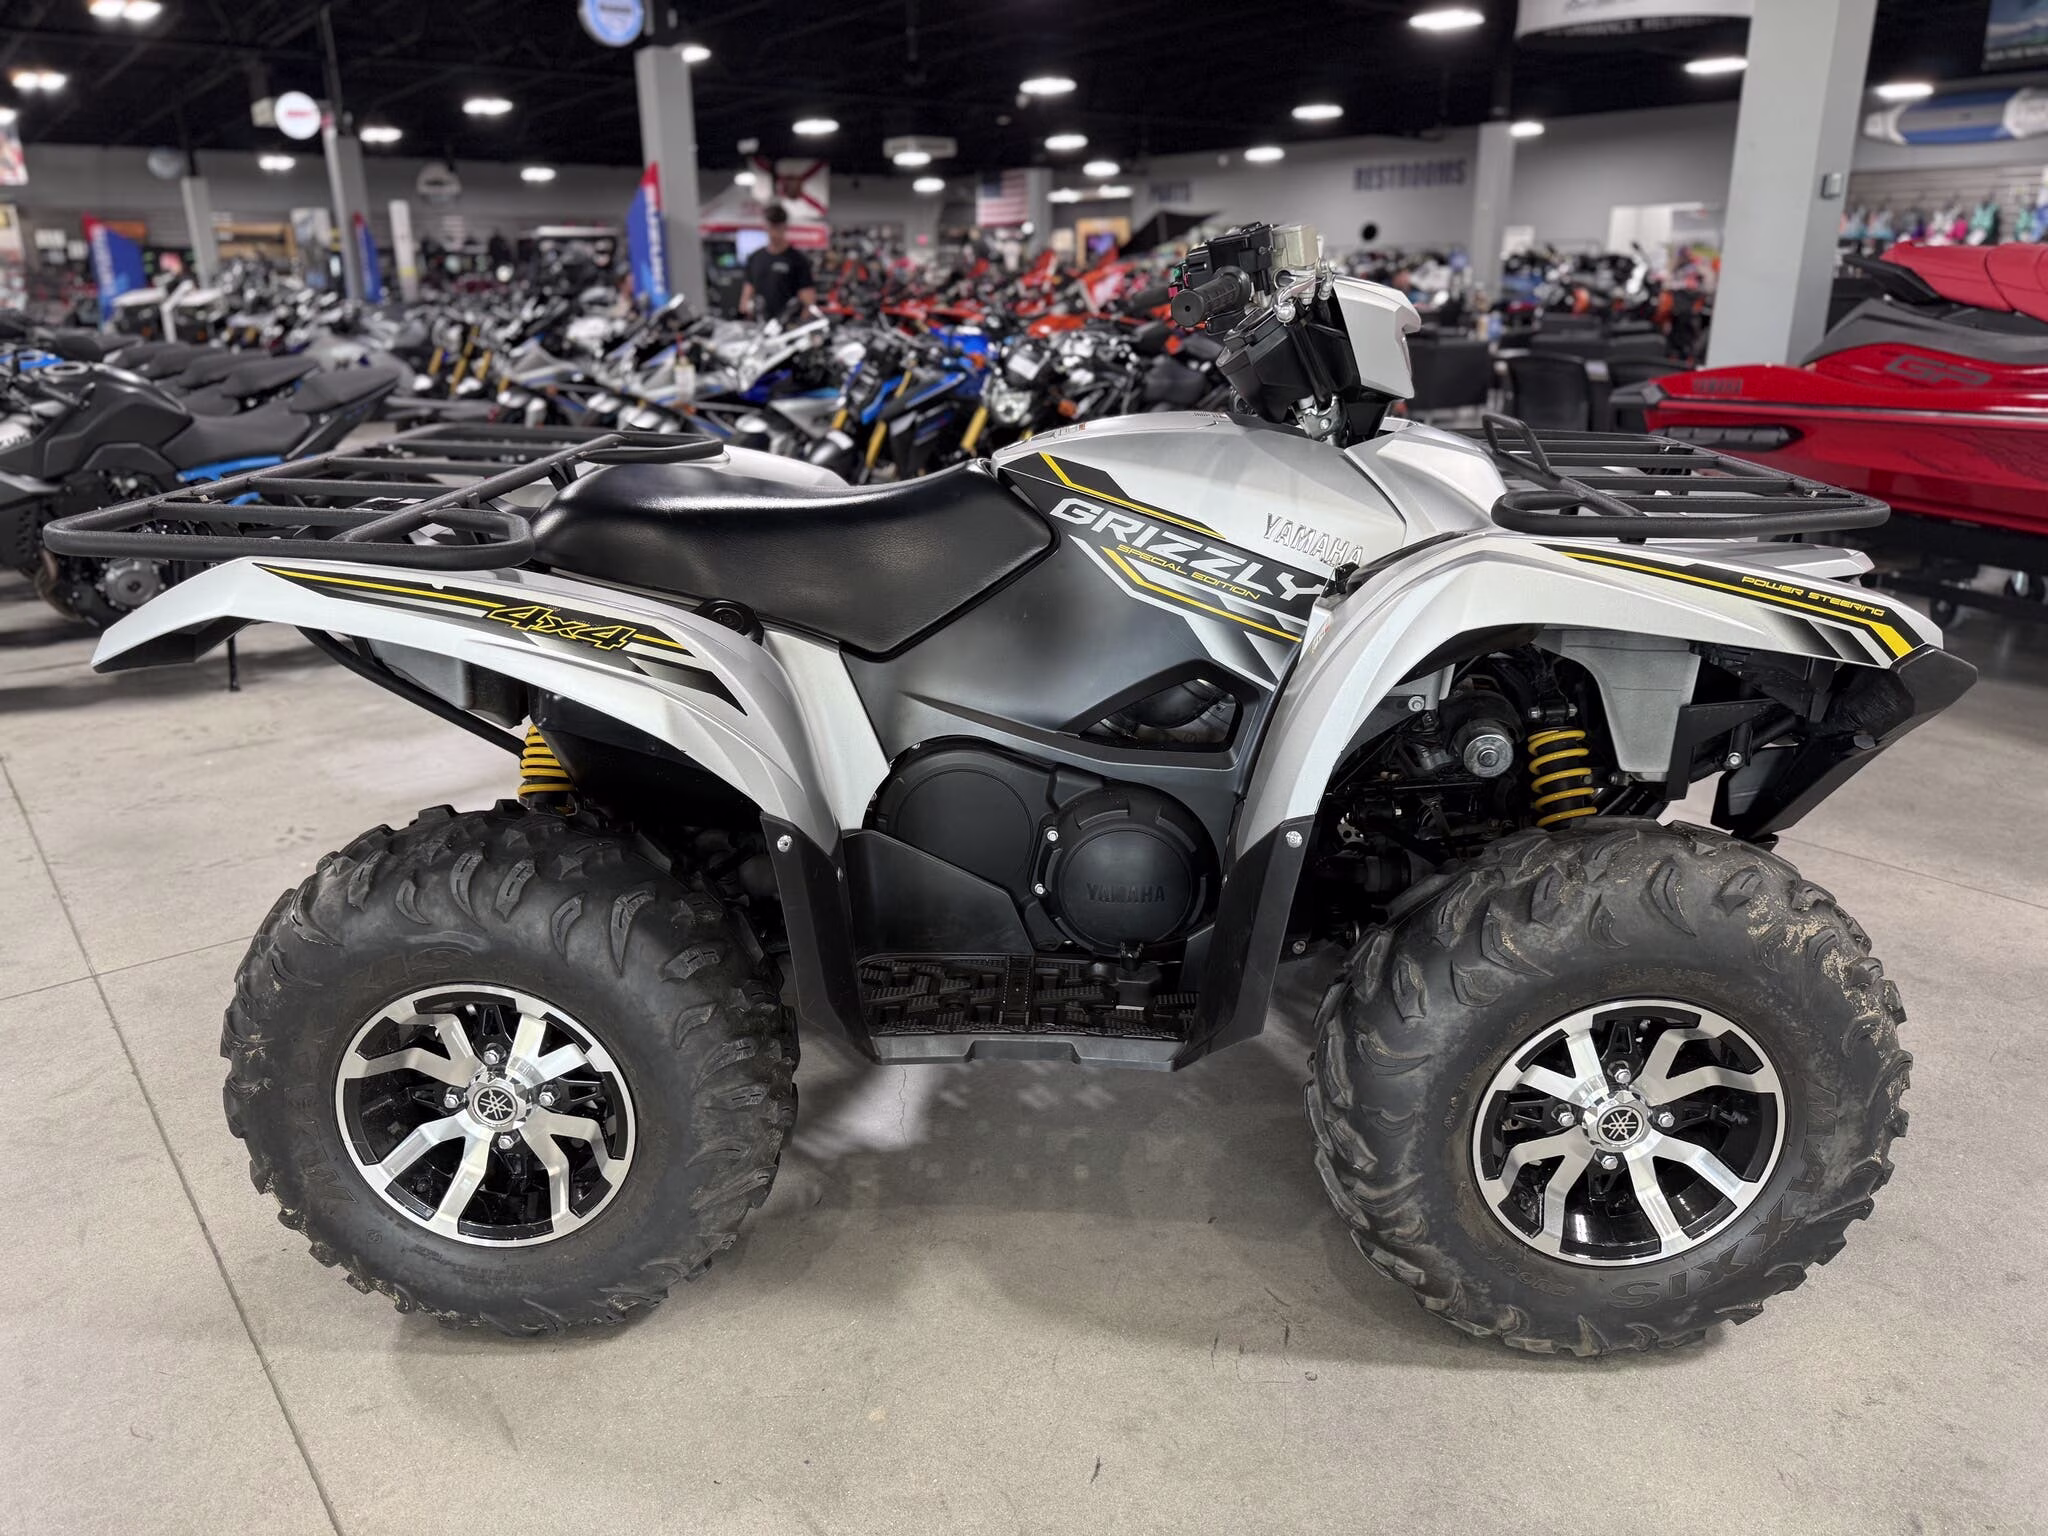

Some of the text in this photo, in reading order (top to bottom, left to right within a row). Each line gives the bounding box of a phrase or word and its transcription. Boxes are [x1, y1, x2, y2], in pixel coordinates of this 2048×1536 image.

[1886, 354, 1994, 386] GP
[1050, 497, 1326, 602] GRIZZLY
[1263, 512, 1364, 567] YAMAHA
[1115, 543, 1261, 601] SPECIAL EDITION
[1741, 575, 1886, 617] POWER STEERING
